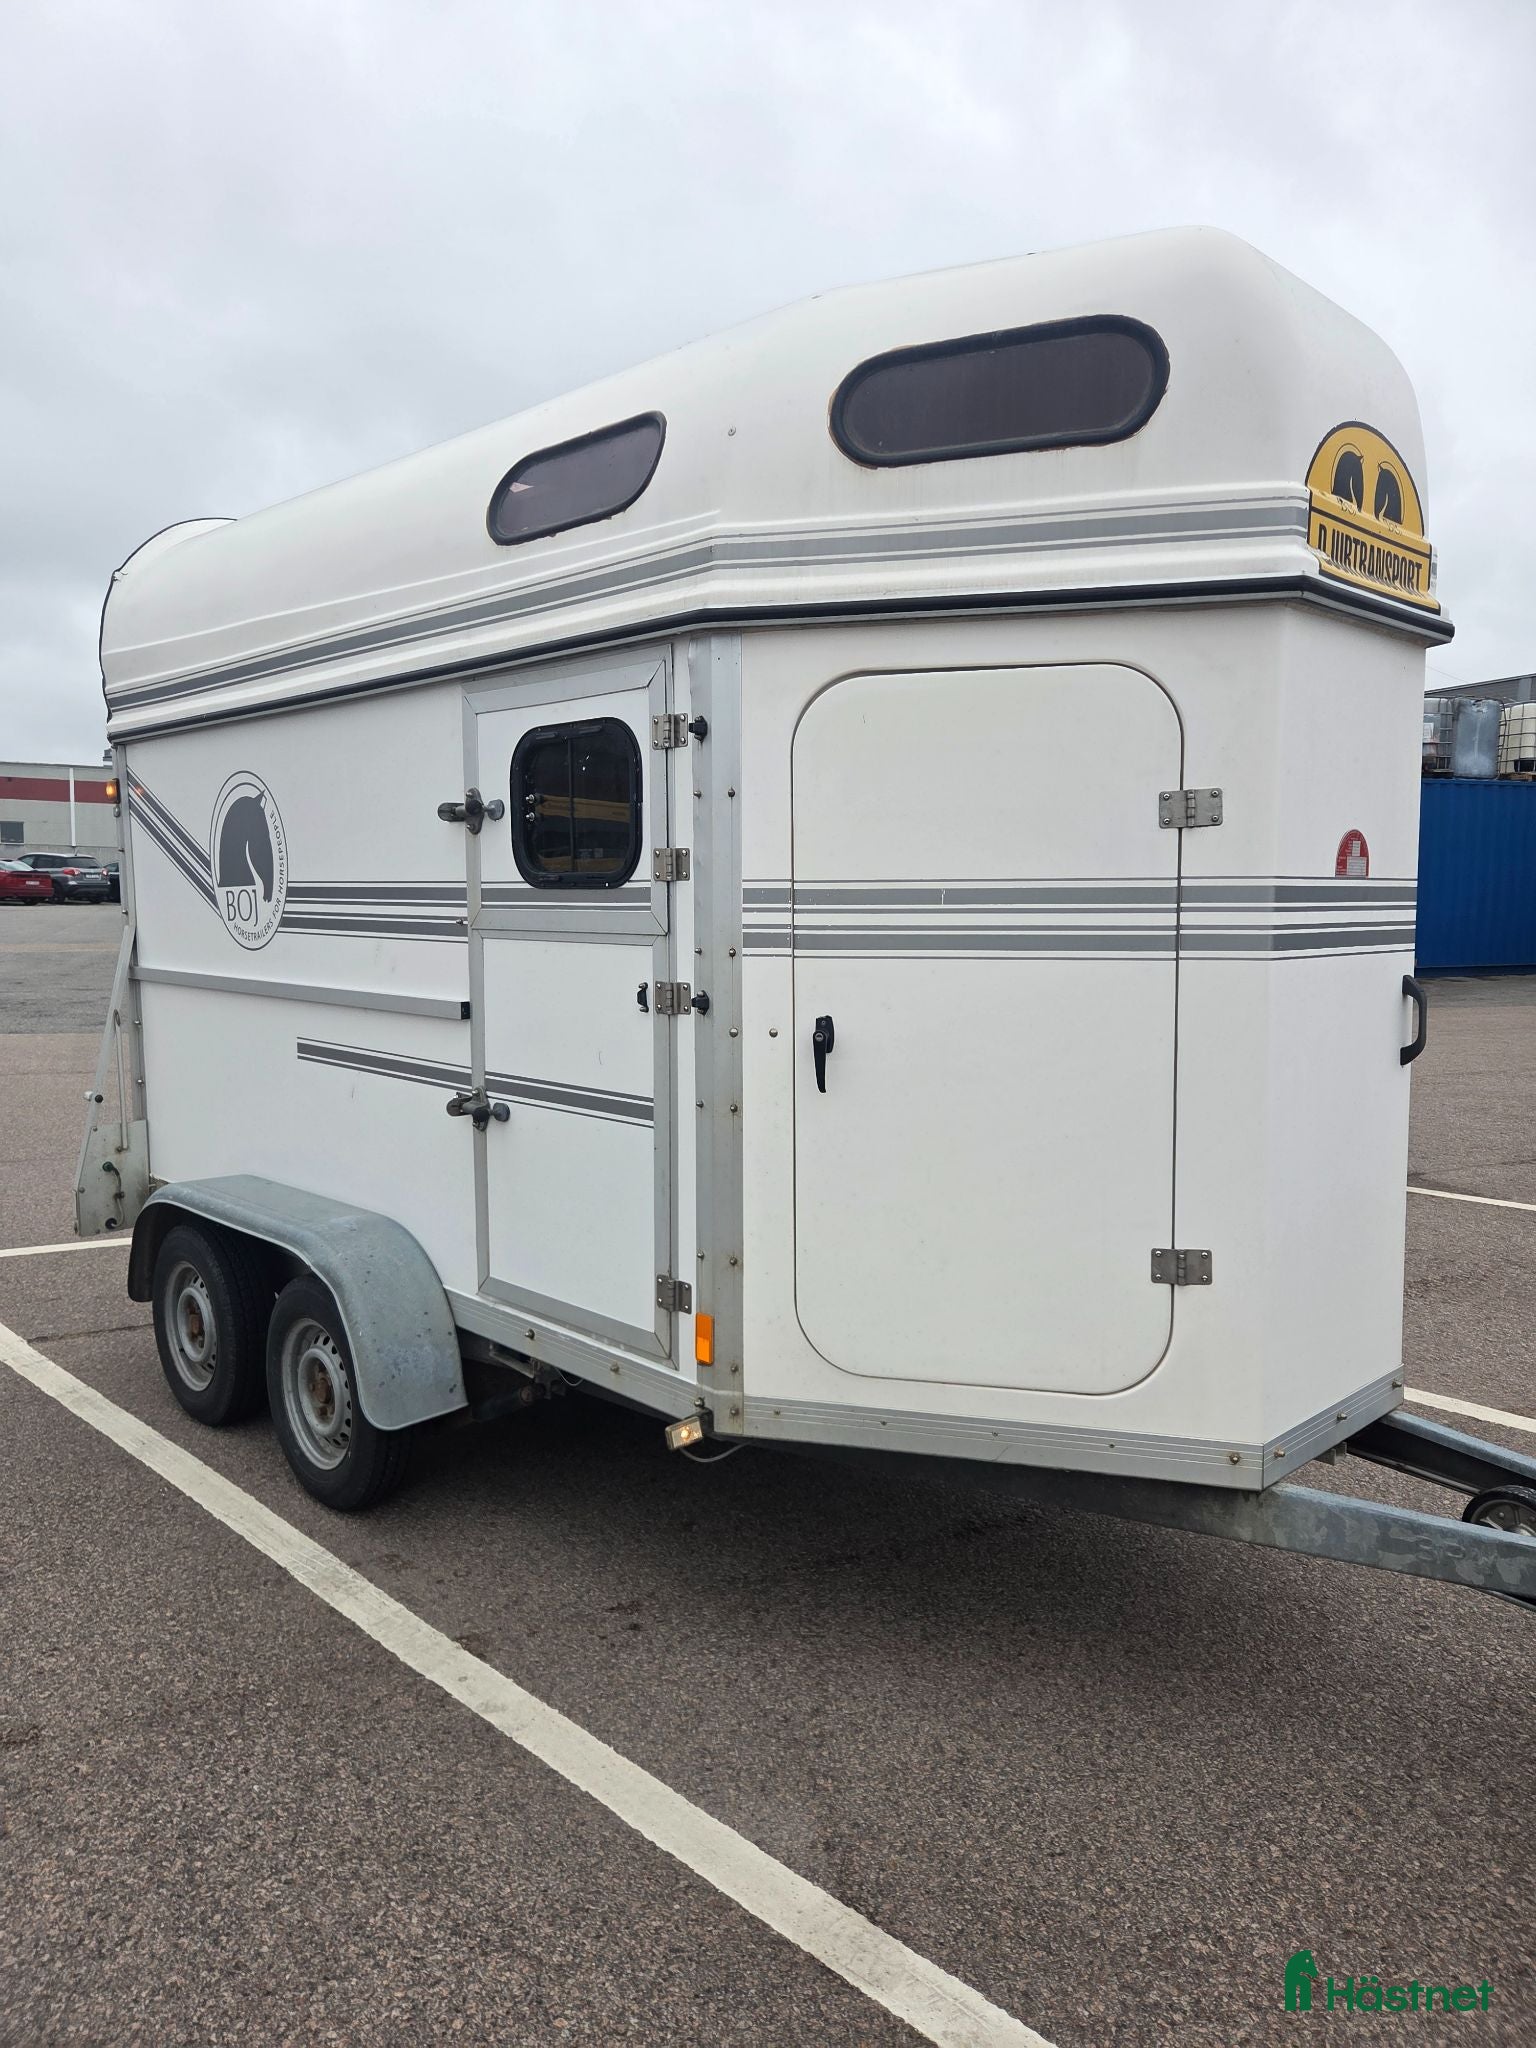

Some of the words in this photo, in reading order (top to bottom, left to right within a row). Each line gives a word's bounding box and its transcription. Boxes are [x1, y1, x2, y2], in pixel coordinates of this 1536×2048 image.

[269, 809, 285, 894] HORSEPEOPLE
[226, 889, 258, 927] BOJ
[272, 897, 281, 919] FOR
[234, 919, 274, 941] HORSETRAILERS
